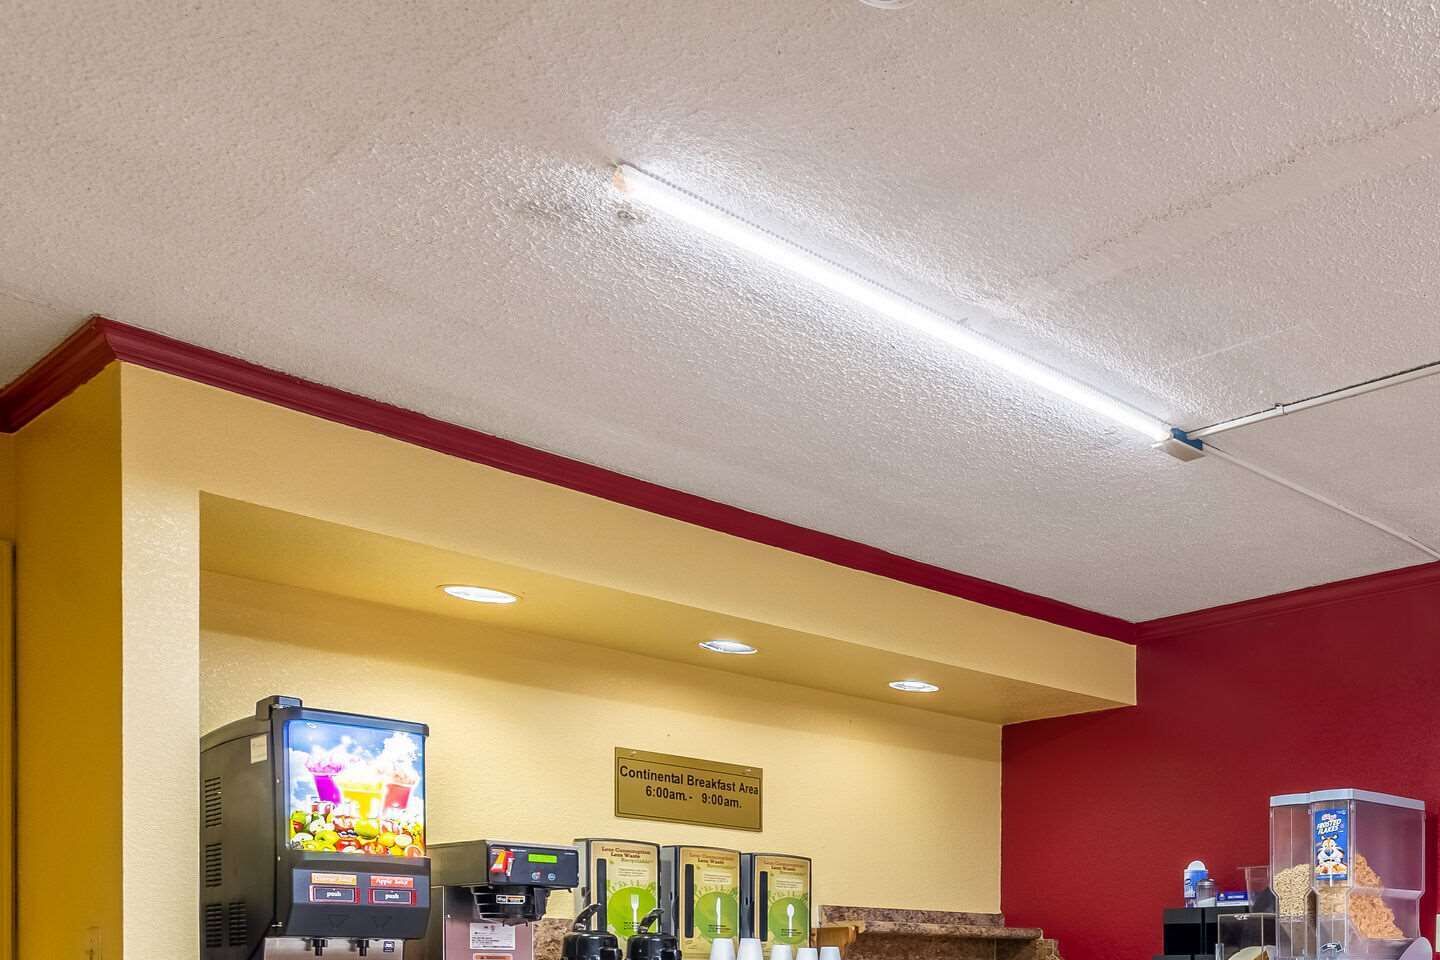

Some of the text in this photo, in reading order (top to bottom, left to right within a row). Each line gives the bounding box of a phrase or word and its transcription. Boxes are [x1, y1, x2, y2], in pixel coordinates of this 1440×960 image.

[620, 765, 759, 796] Continental Breakfast Area
[701, 792, 742, 809] 9:00am.
